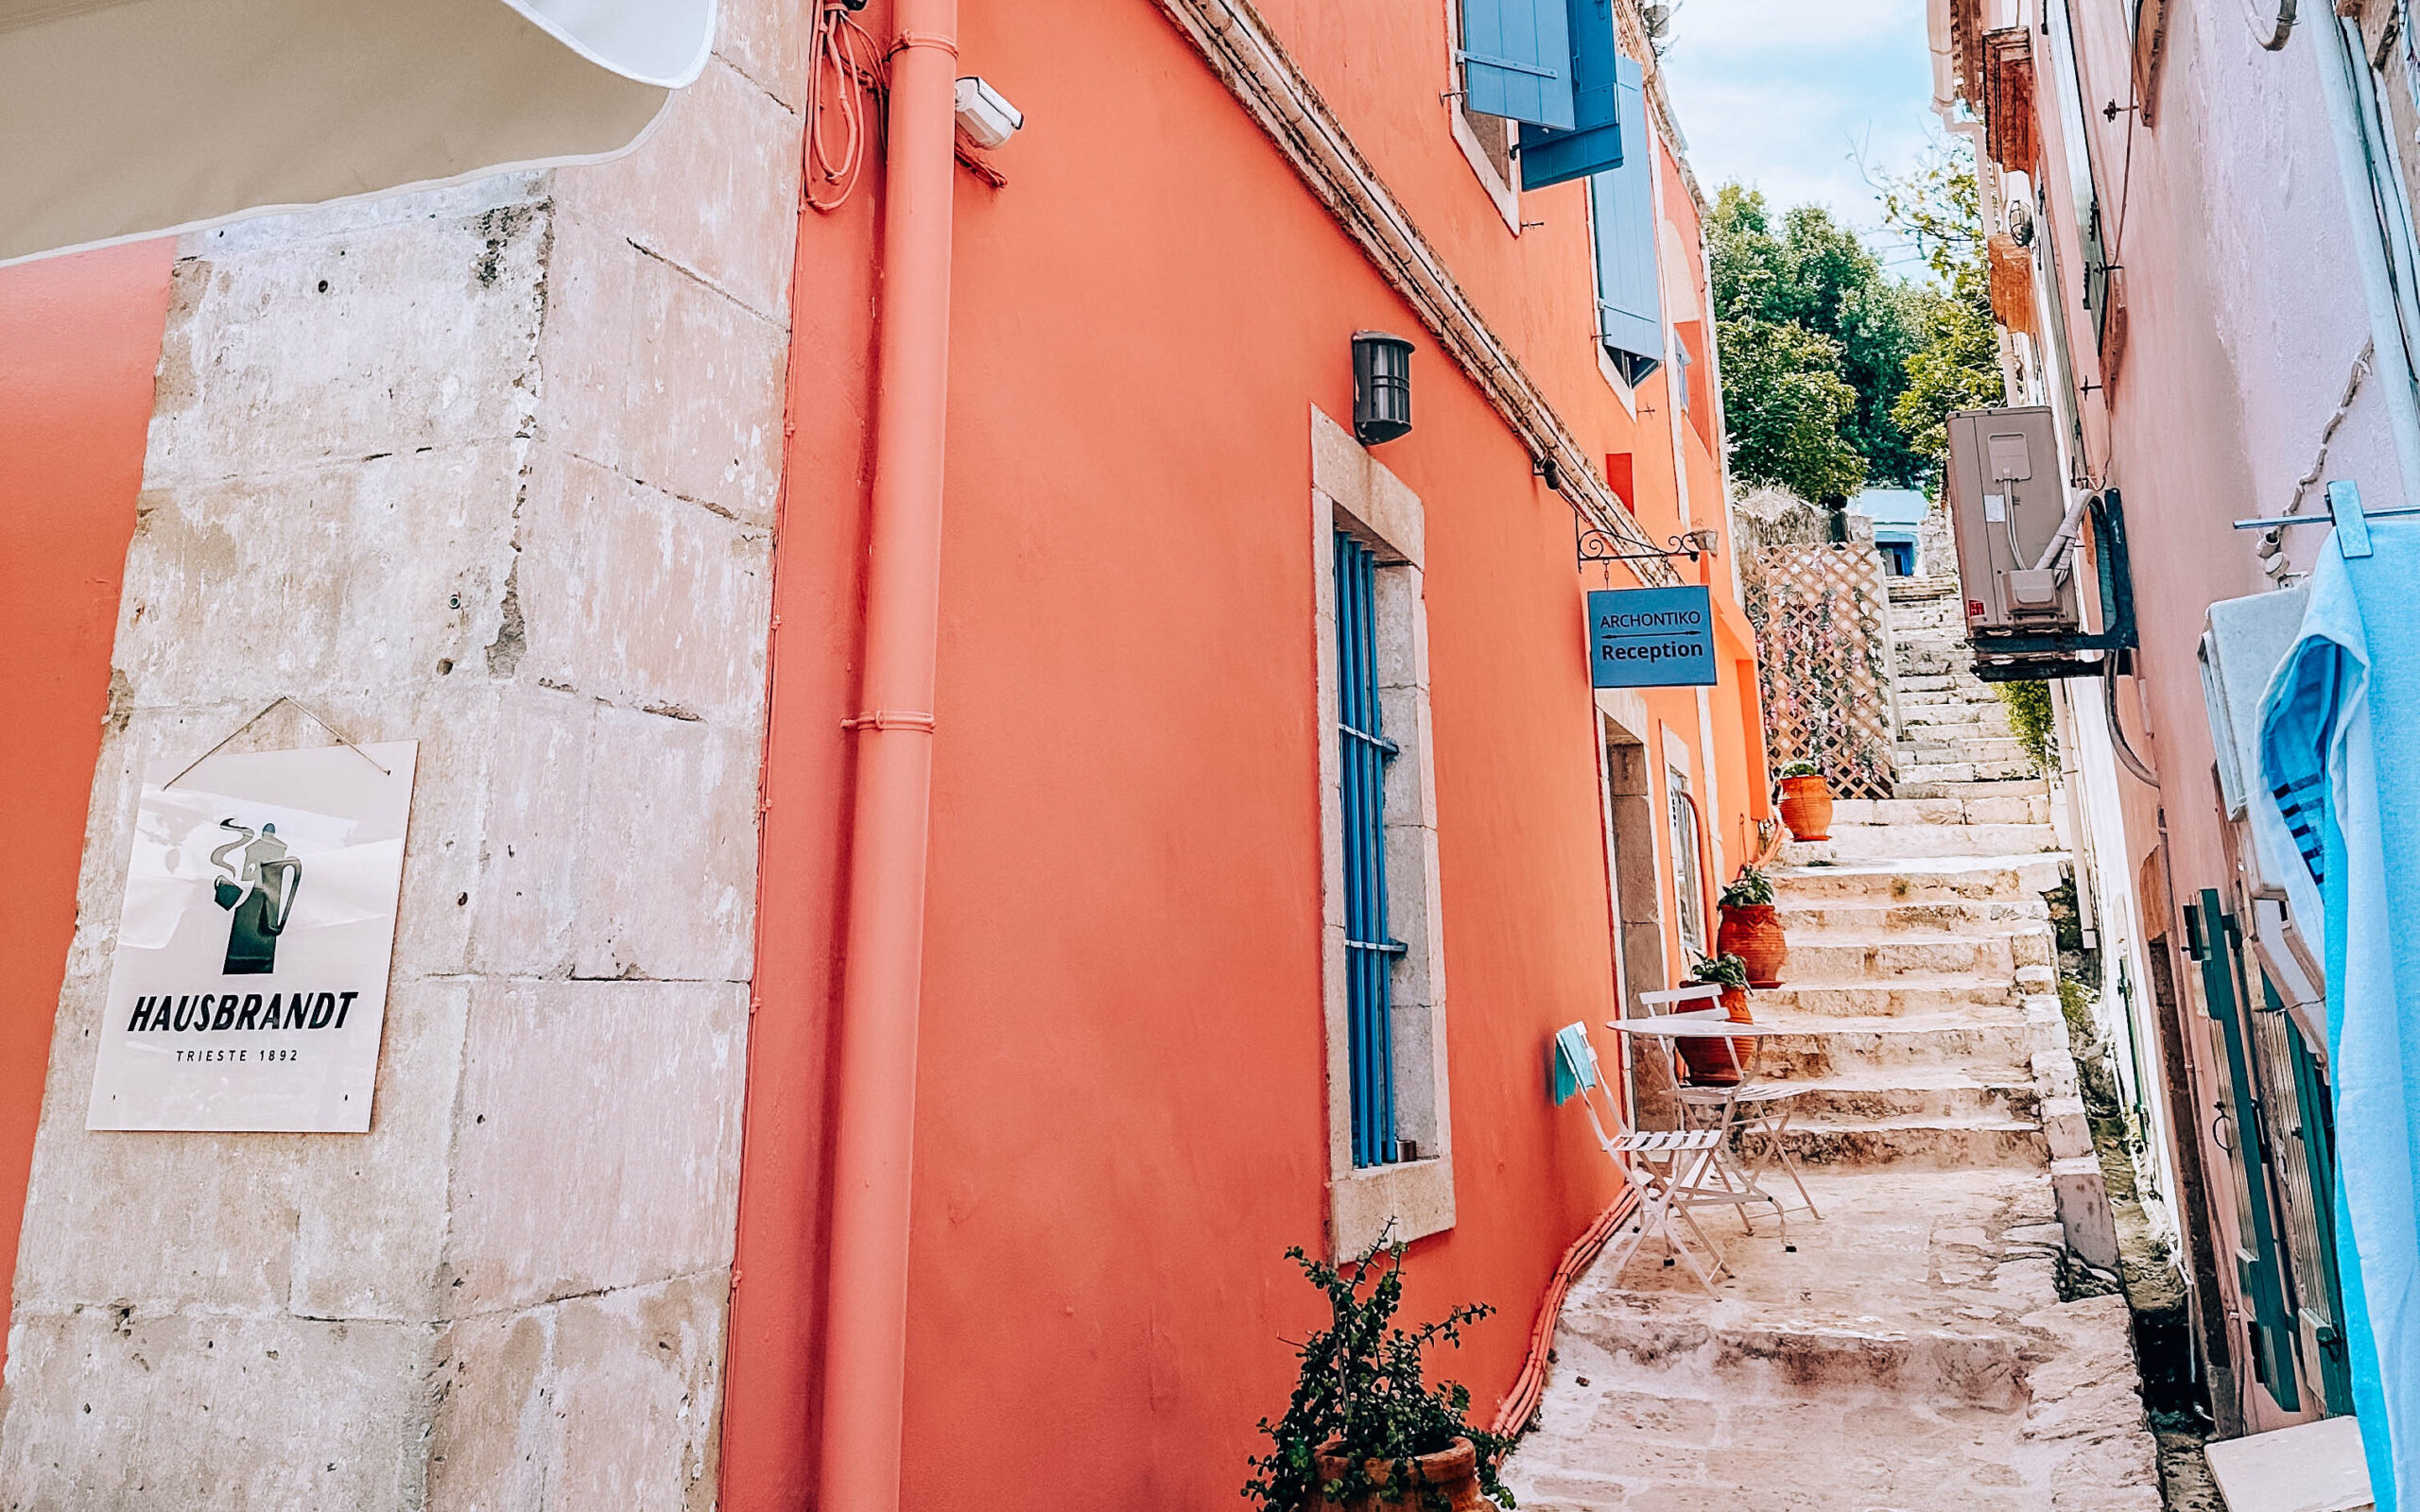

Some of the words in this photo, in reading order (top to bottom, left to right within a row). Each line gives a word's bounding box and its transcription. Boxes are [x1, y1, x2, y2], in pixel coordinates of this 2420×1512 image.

[1599, 610, 1701, 629] ARCHONTIKO
[1601, 641, 1703, 663] Reception
[127, 991, 359, 1032] HAUSBRANDT
[176, 1050, 248, 1062] TRIESTE
[259, 1049, 299, 1062] 1892
